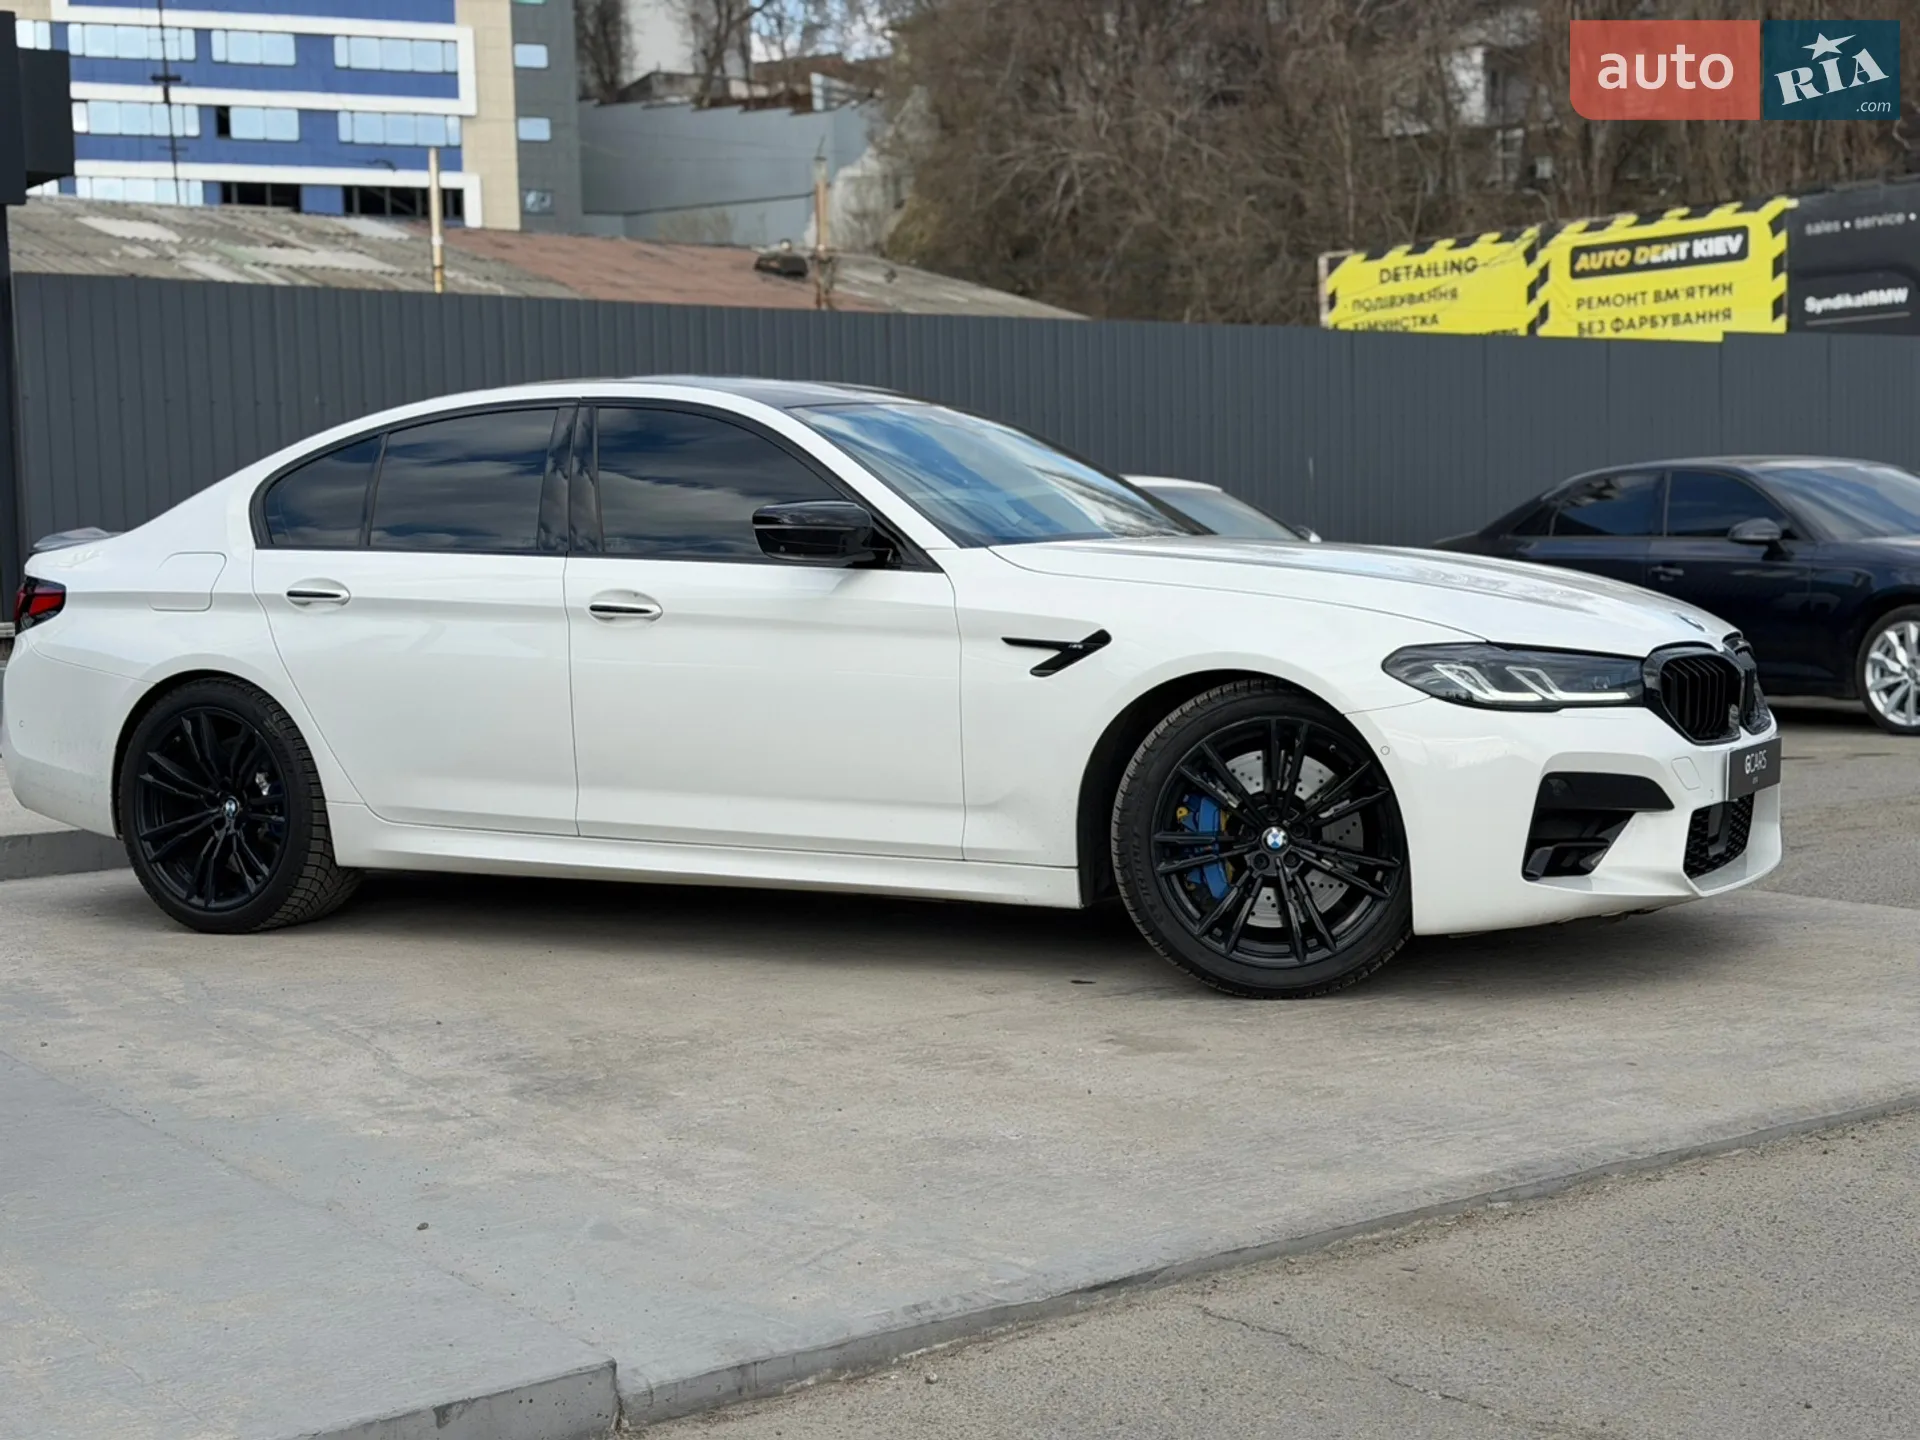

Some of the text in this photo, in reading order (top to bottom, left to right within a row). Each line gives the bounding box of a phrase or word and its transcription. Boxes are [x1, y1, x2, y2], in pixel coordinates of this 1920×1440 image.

[1805, 212, 1906, 236] sales service
[1574, 233, 1744, 272] AUTO DENT KIEV
[1379, 256, 1479, 285] DETAILING
[1576, 290, 1649, 312] РЕМОНТ
[1804, 286, 1909, 314] SyndikatBMW
[1577, 307, 1733, 336] БЕЗ ФАРБУВАННЯ
